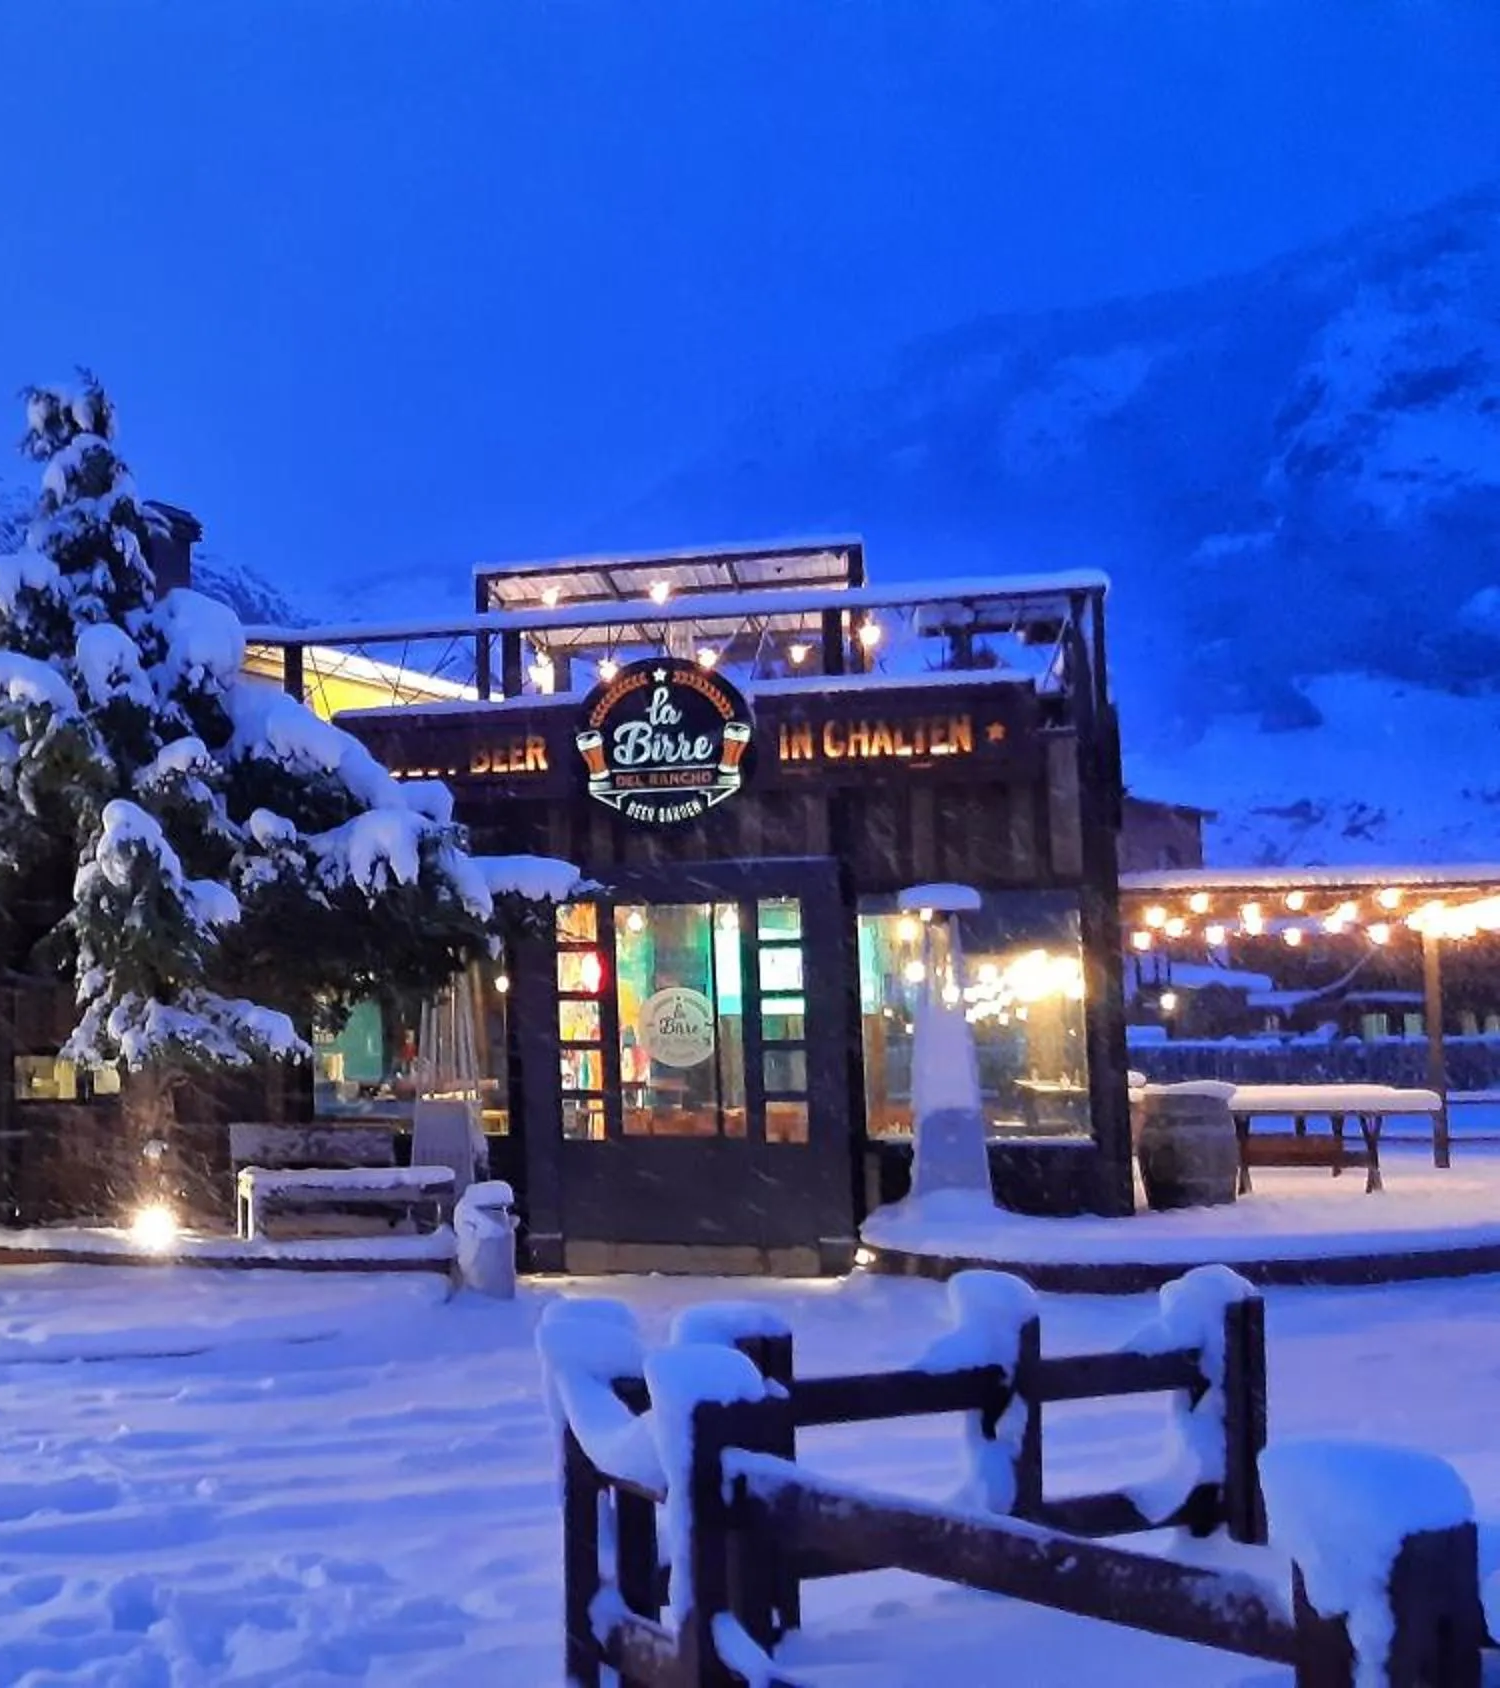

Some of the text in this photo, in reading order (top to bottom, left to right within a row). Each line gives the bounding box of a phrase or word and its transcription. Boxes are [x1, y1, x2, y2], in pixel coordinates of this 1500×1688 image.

[645, 687, 682, 725] la
[613, 720, 713, 765] Birre
[779, 715, 972, 760] IN CHALTEN
[615, 770, 713, 787] DEL RANCHO
[626, 799, 703, 823] BEER GARDEN
